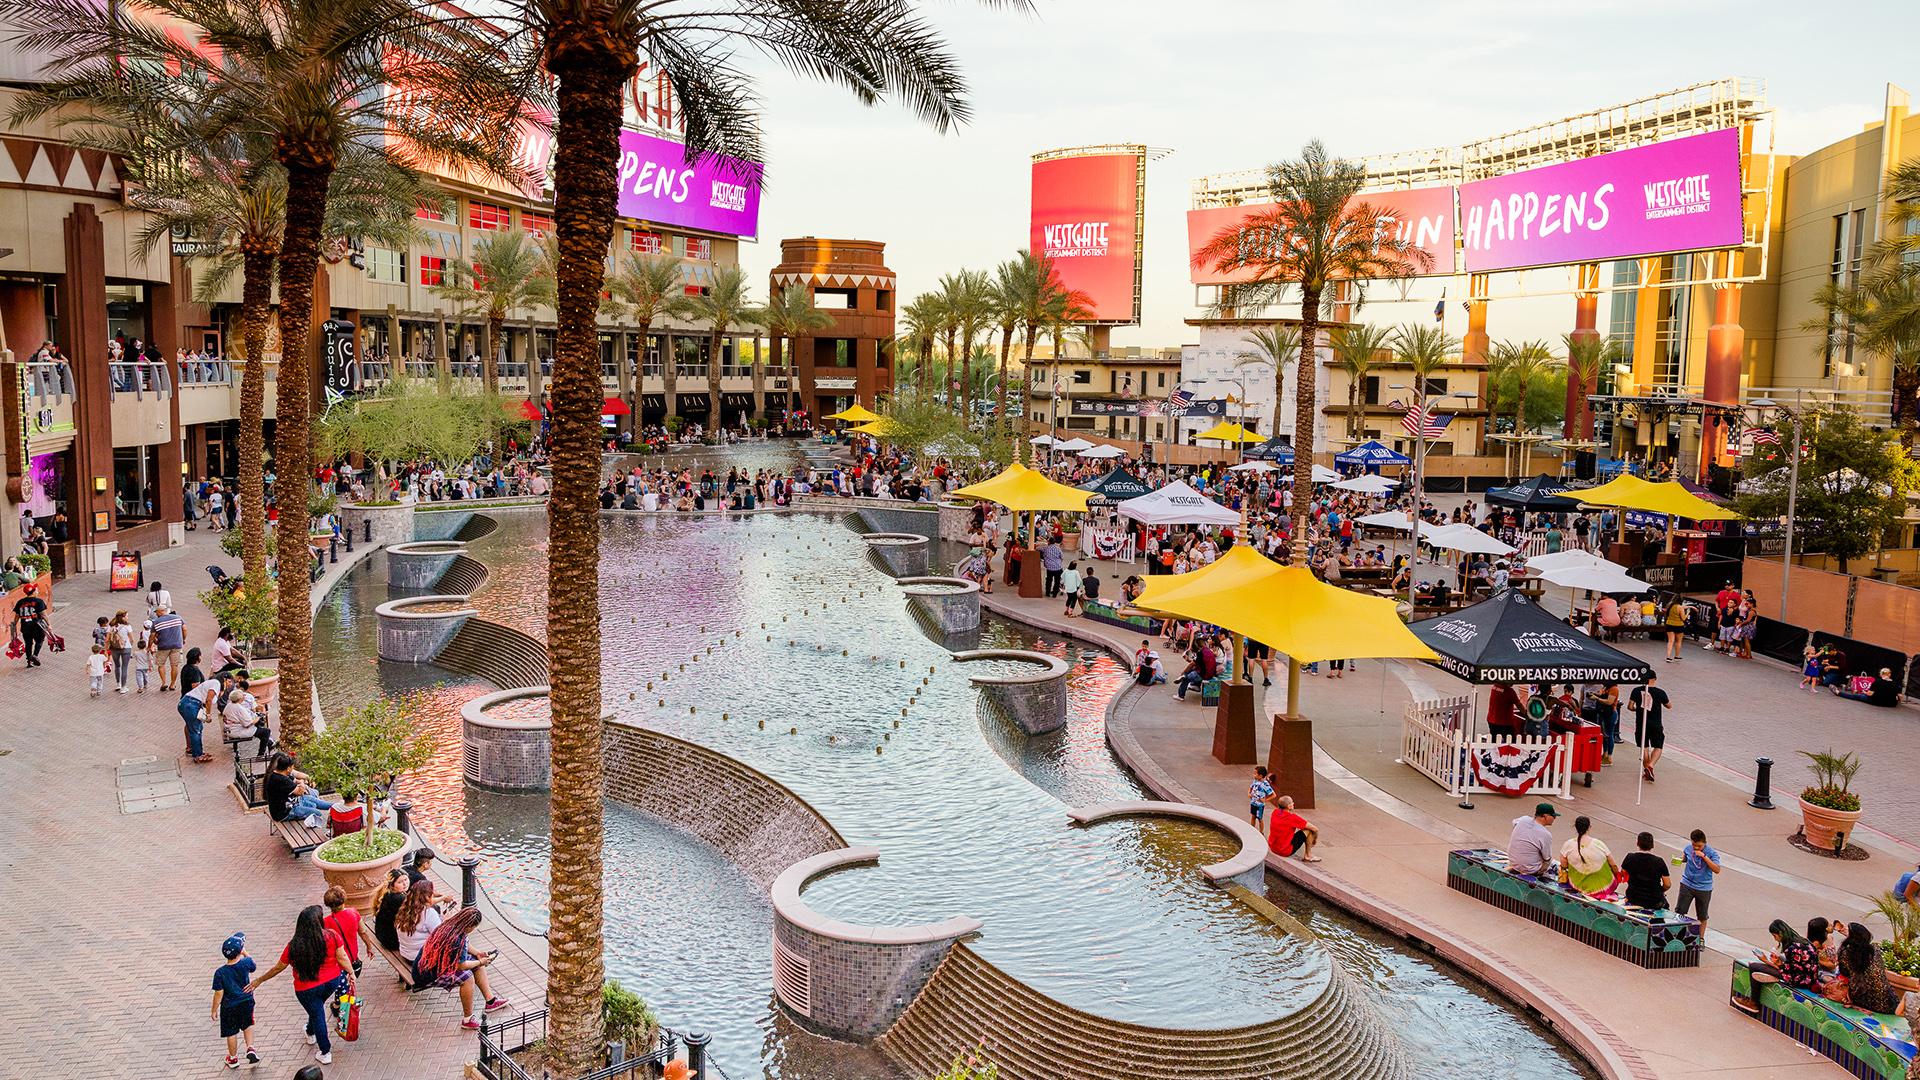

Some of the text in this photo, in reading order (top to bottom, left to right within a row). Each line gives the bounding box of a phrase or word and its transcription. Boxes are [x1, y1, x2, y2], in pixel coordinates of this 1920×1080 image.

[617, 151, 695, 204] PENS
[712, 179, 747, 206] WESTGATE
[1643, 174, 1711, 209] WESTGATE
[1645, 202, 1711, 220] ENTERTAINMENT DISTRICT
[1371, 214, 1444, 258] FUN
[1465, 182, 1615, 250] HAPPENS
[1044, 222, 1109, 249] WESTGATE
[1081, 248, 1108, 257] DISTRICT
[322, 322, 339, 387] Bar Louie
[1104, 484, 1145, 493] FOUR PEAKS
[1168, 496, 1205, 505] WESTGATE
[1645, 568, 1674, 582] WESTGATE
[1511, 637, 1583, 652] FOUR PEAKS
[1457, 662, 1470, 679] CO.
[1480, 668, 1517, 681] FOUR
[1519, 668, 1558, 680] PEAKS
[1560, 668, 1619, 680] BREWING
